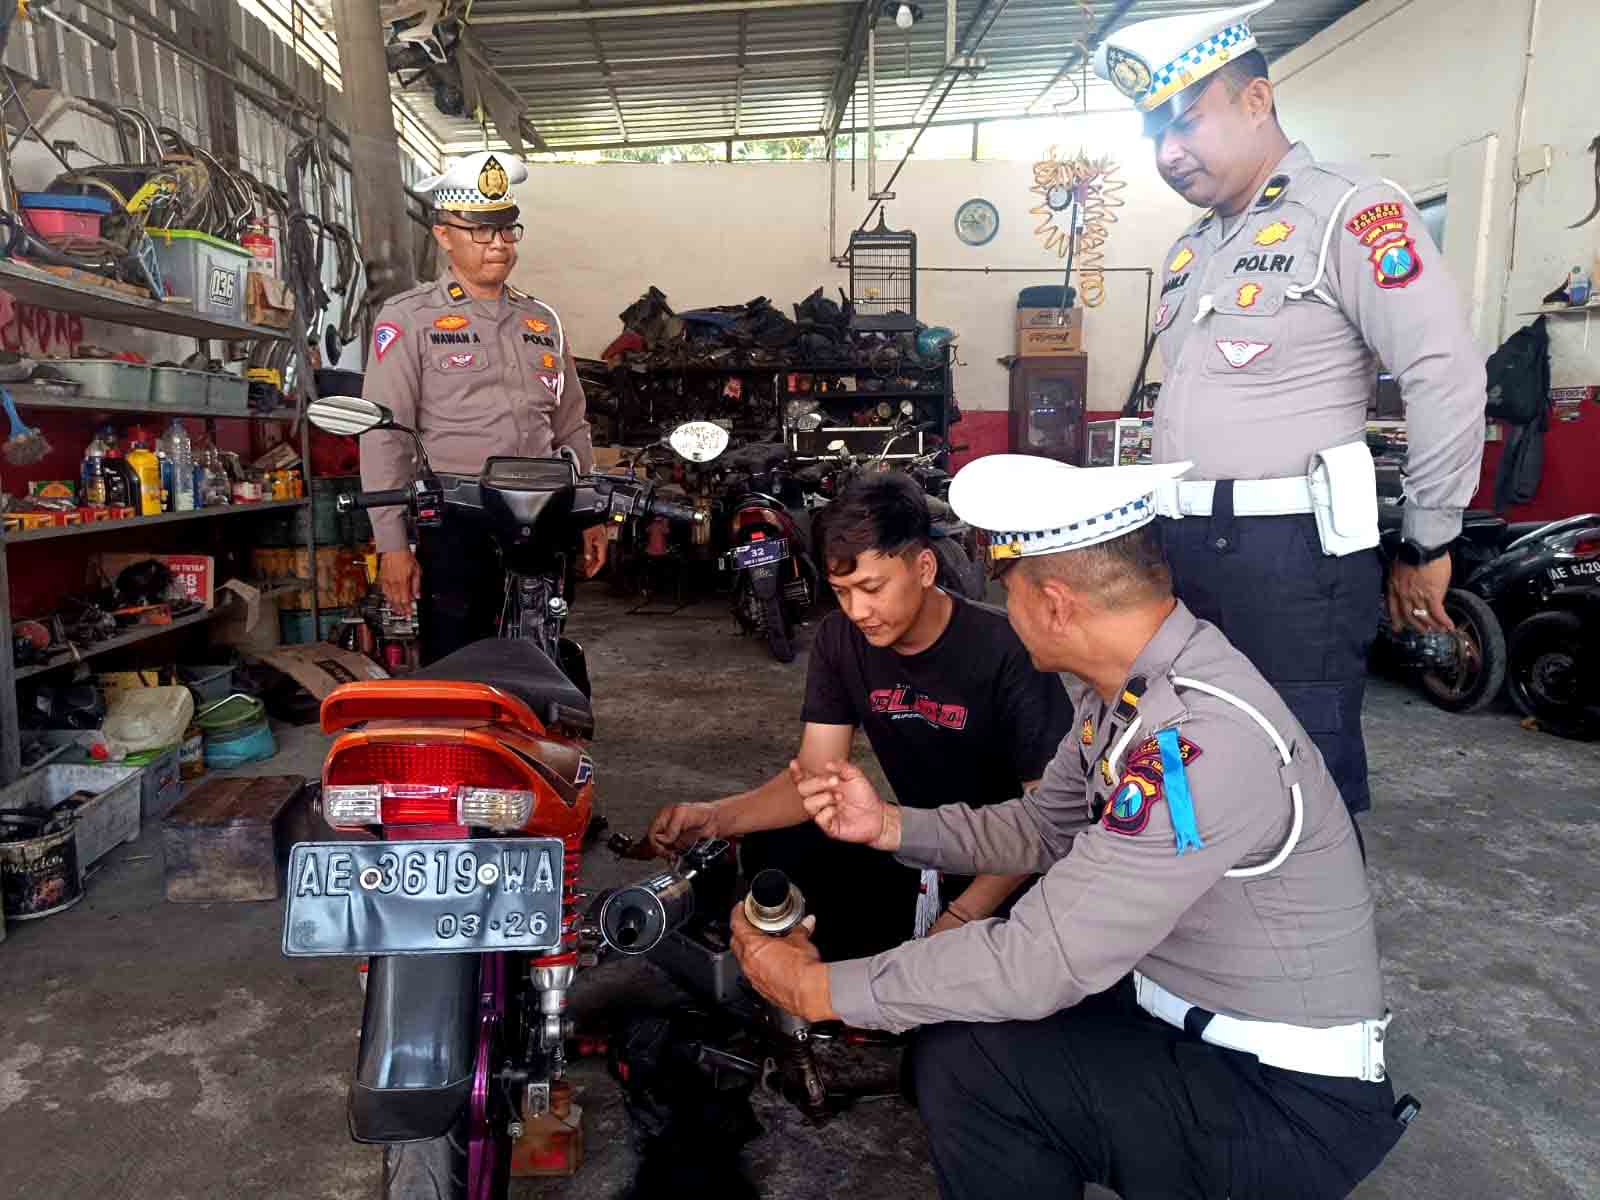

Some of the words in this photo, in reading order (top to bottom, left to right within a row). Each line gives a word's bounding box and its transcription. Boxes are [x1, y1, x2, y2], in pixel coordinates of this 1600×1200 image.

[1233, 254, 1295, 273] POLRI
[430, 333, 470, 345] WAWAN
[472, 333, 481, 343] A
[297, 852, 352, 897] AE
[376, 850, 479, 895] 3619
[502, 849, 554, 894] WA
